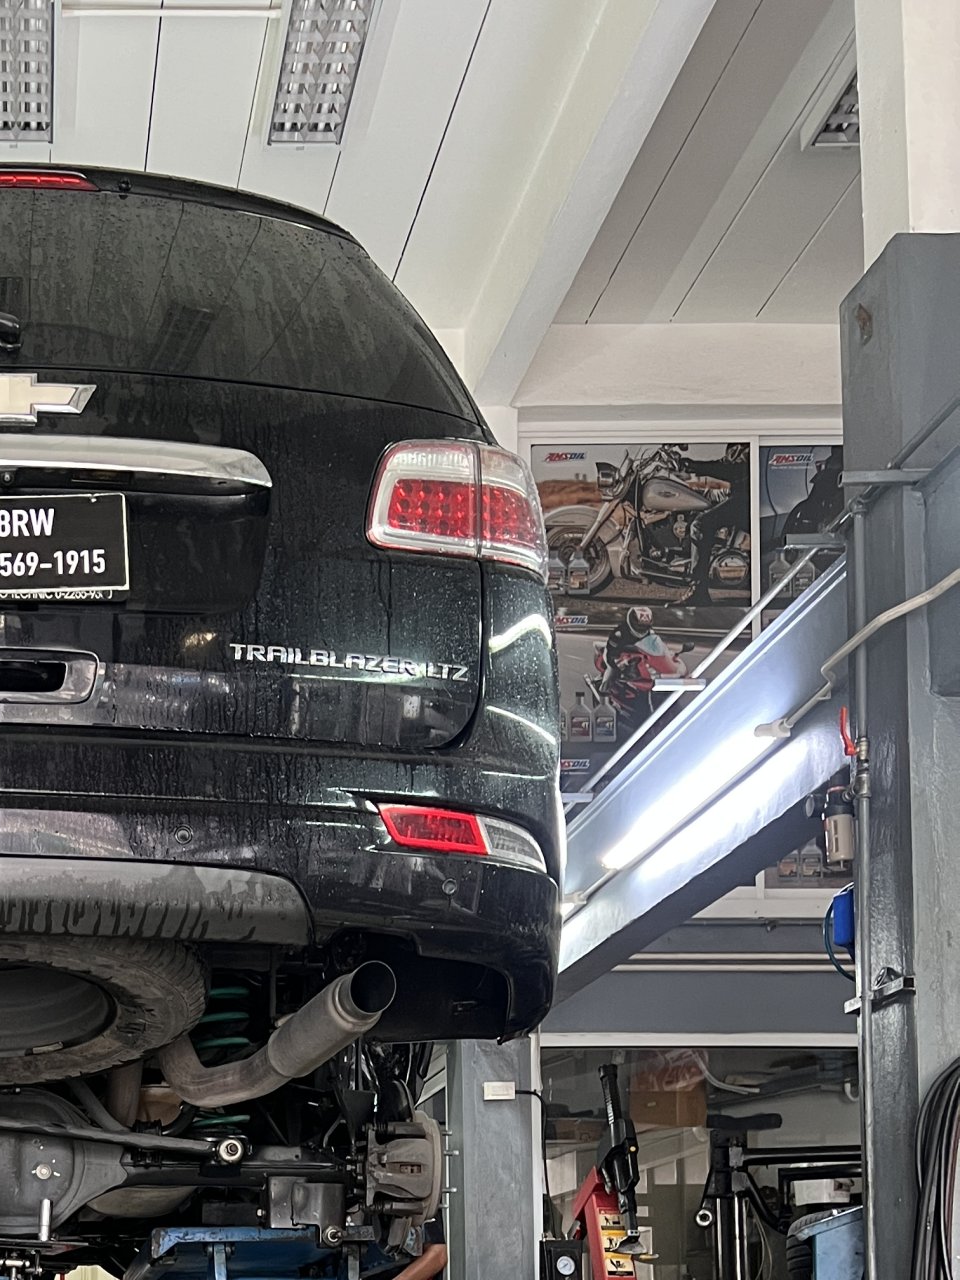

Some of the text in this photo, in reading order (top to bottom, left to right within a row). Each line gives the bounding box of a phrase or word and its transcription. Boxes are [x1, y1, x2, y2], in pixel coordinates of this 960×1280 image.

[544, 452, 586, 462] AMSOIL
[555, 616, 588, 625] MSOIL
[229, 643, 469, 682] TRAILBLAZER LTZ
